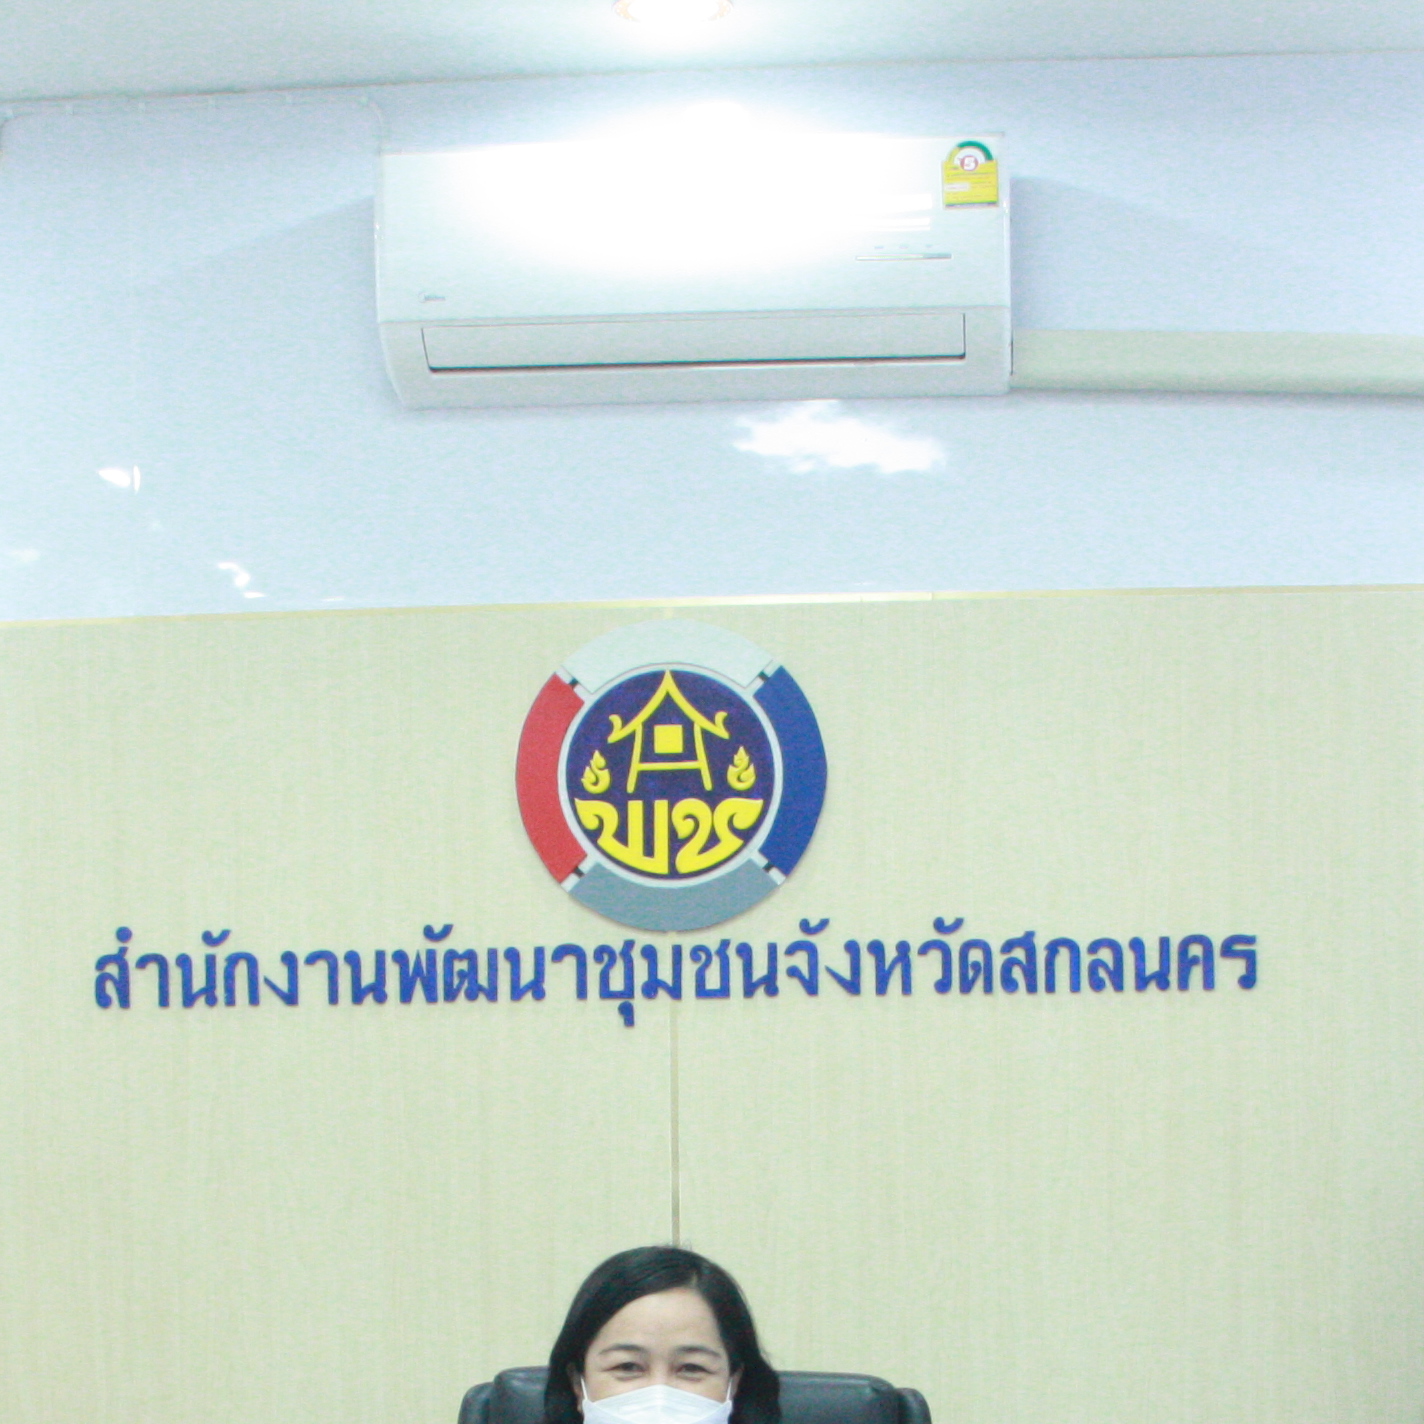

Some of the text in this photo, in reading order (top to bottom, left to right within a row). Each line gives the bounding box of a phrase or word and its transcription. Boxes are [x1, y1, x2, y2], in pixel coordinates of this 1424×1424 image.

[92, 917, 1260, 1026] สำนักงานพัฒนาชุมชนจังหวัดสกลนคร
